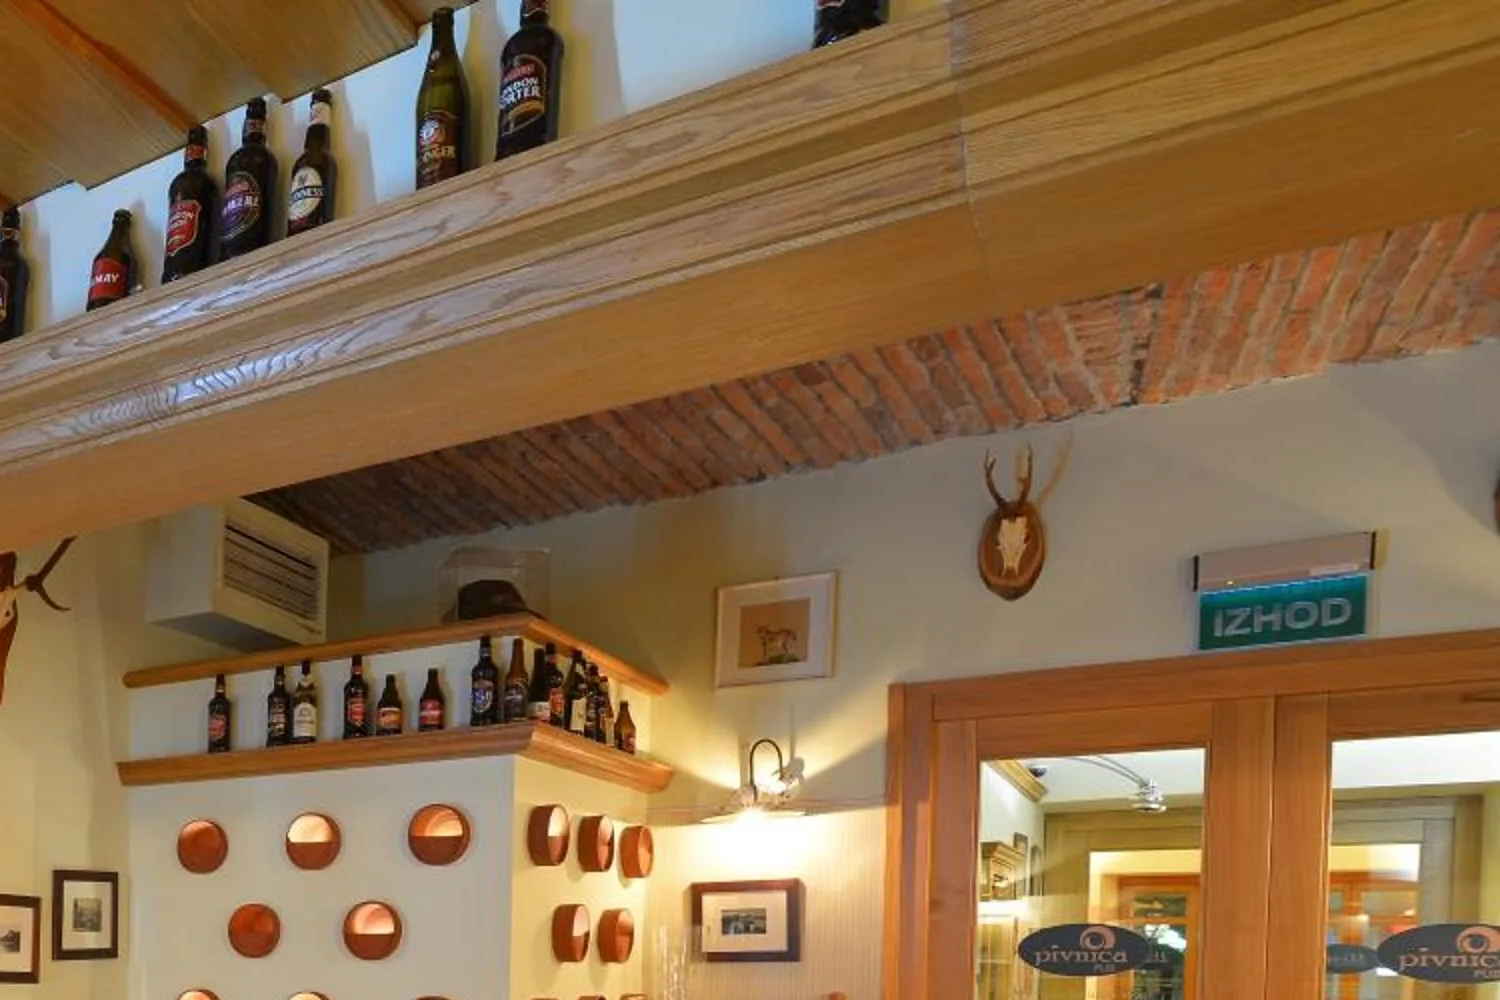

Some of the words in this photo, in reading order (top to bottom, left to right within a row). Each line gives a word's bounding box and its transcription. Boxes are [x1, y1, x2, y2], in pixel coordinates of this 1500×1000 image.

[1213, 597, 1352, 637] IZHOD
[1034, 945, 1129, 965] pivnica
[1400, 947, 1500, 972] pivnic
